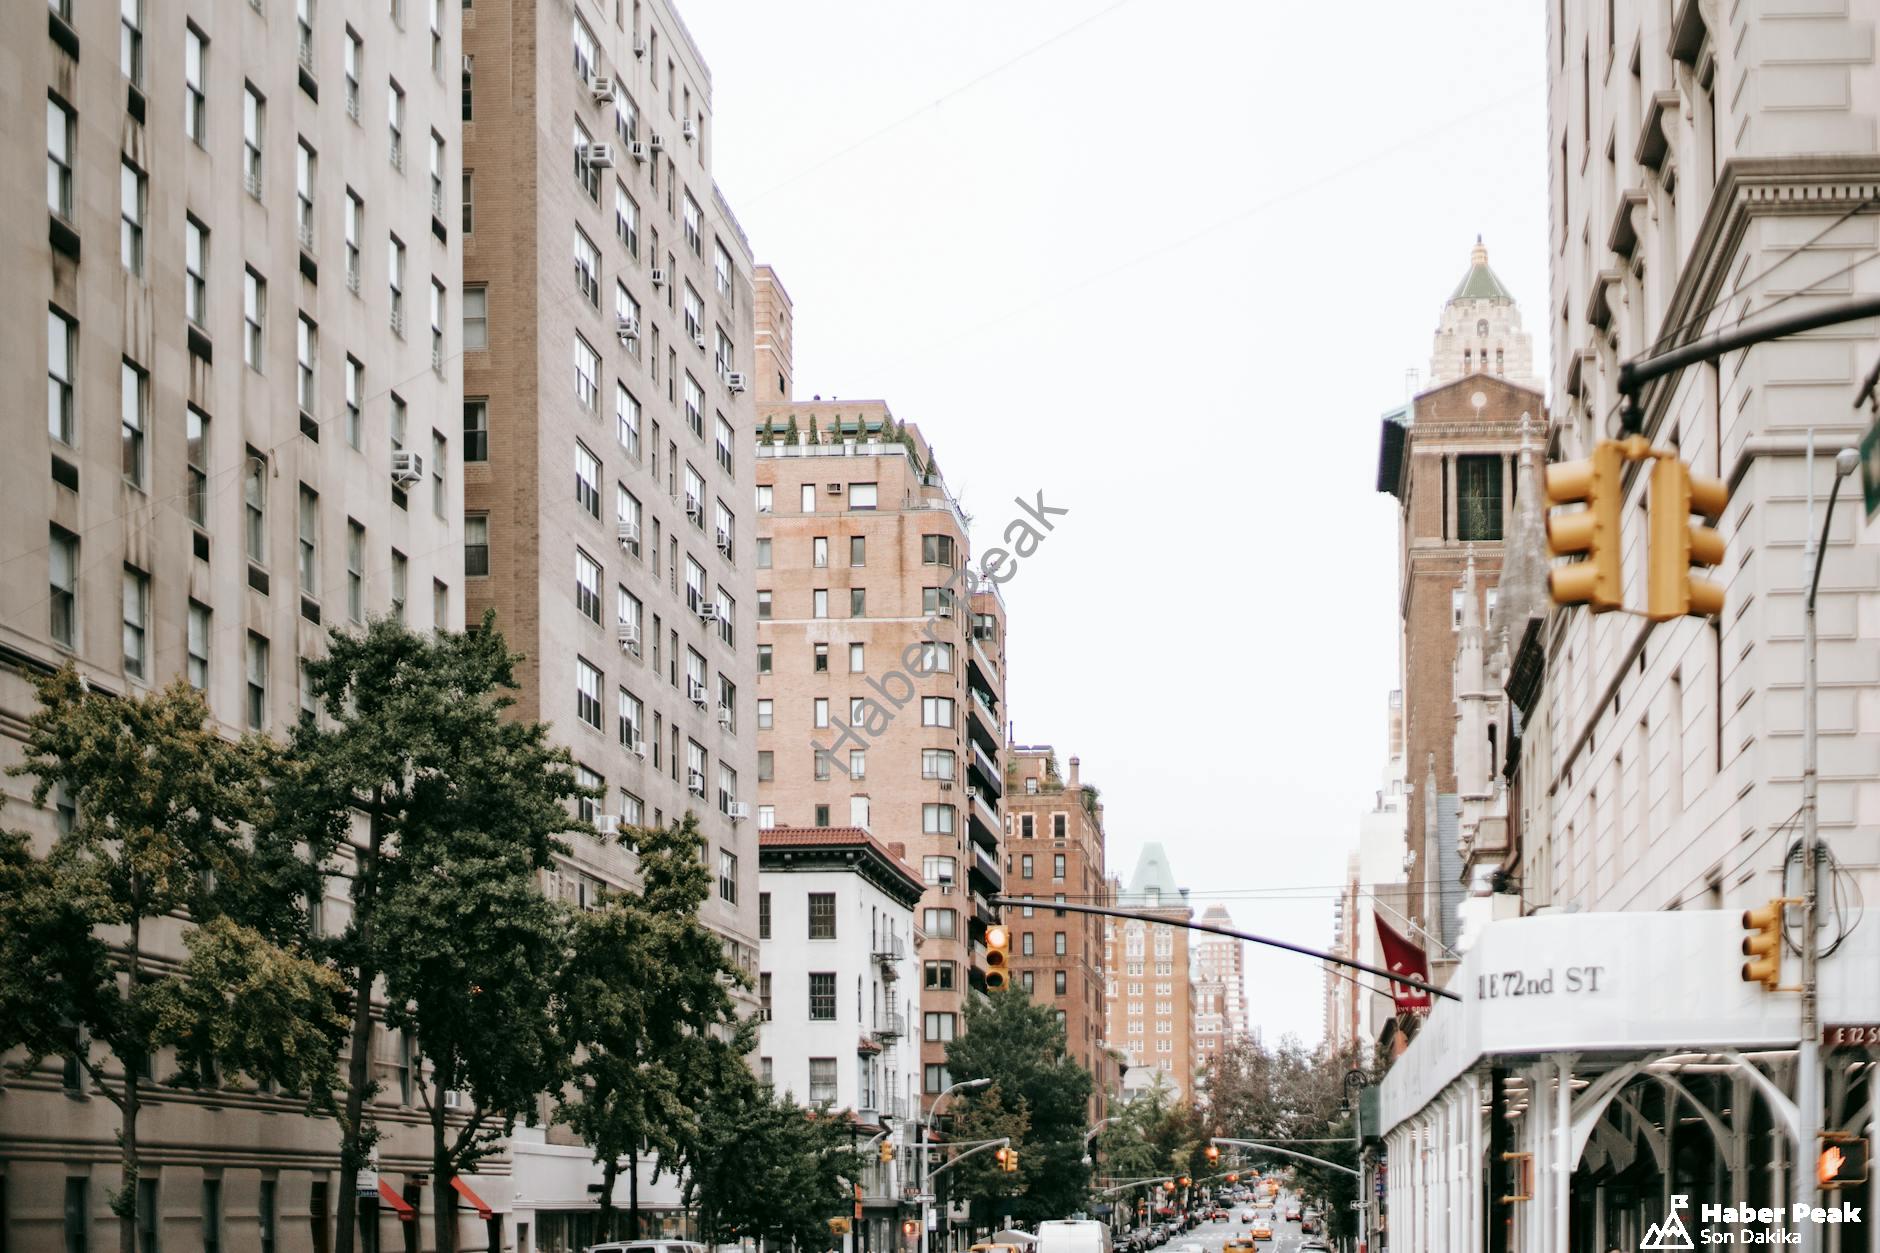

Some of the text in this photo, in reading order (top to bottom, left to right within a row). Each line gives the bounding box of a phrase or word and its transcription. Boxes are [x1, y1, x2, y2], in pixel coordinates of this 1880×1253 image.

[1503, 968, 1554, 996] 72nd
[1565, 966, 1604, 993] ST
[1838, 1027, 1880, 1042] E 72 S
